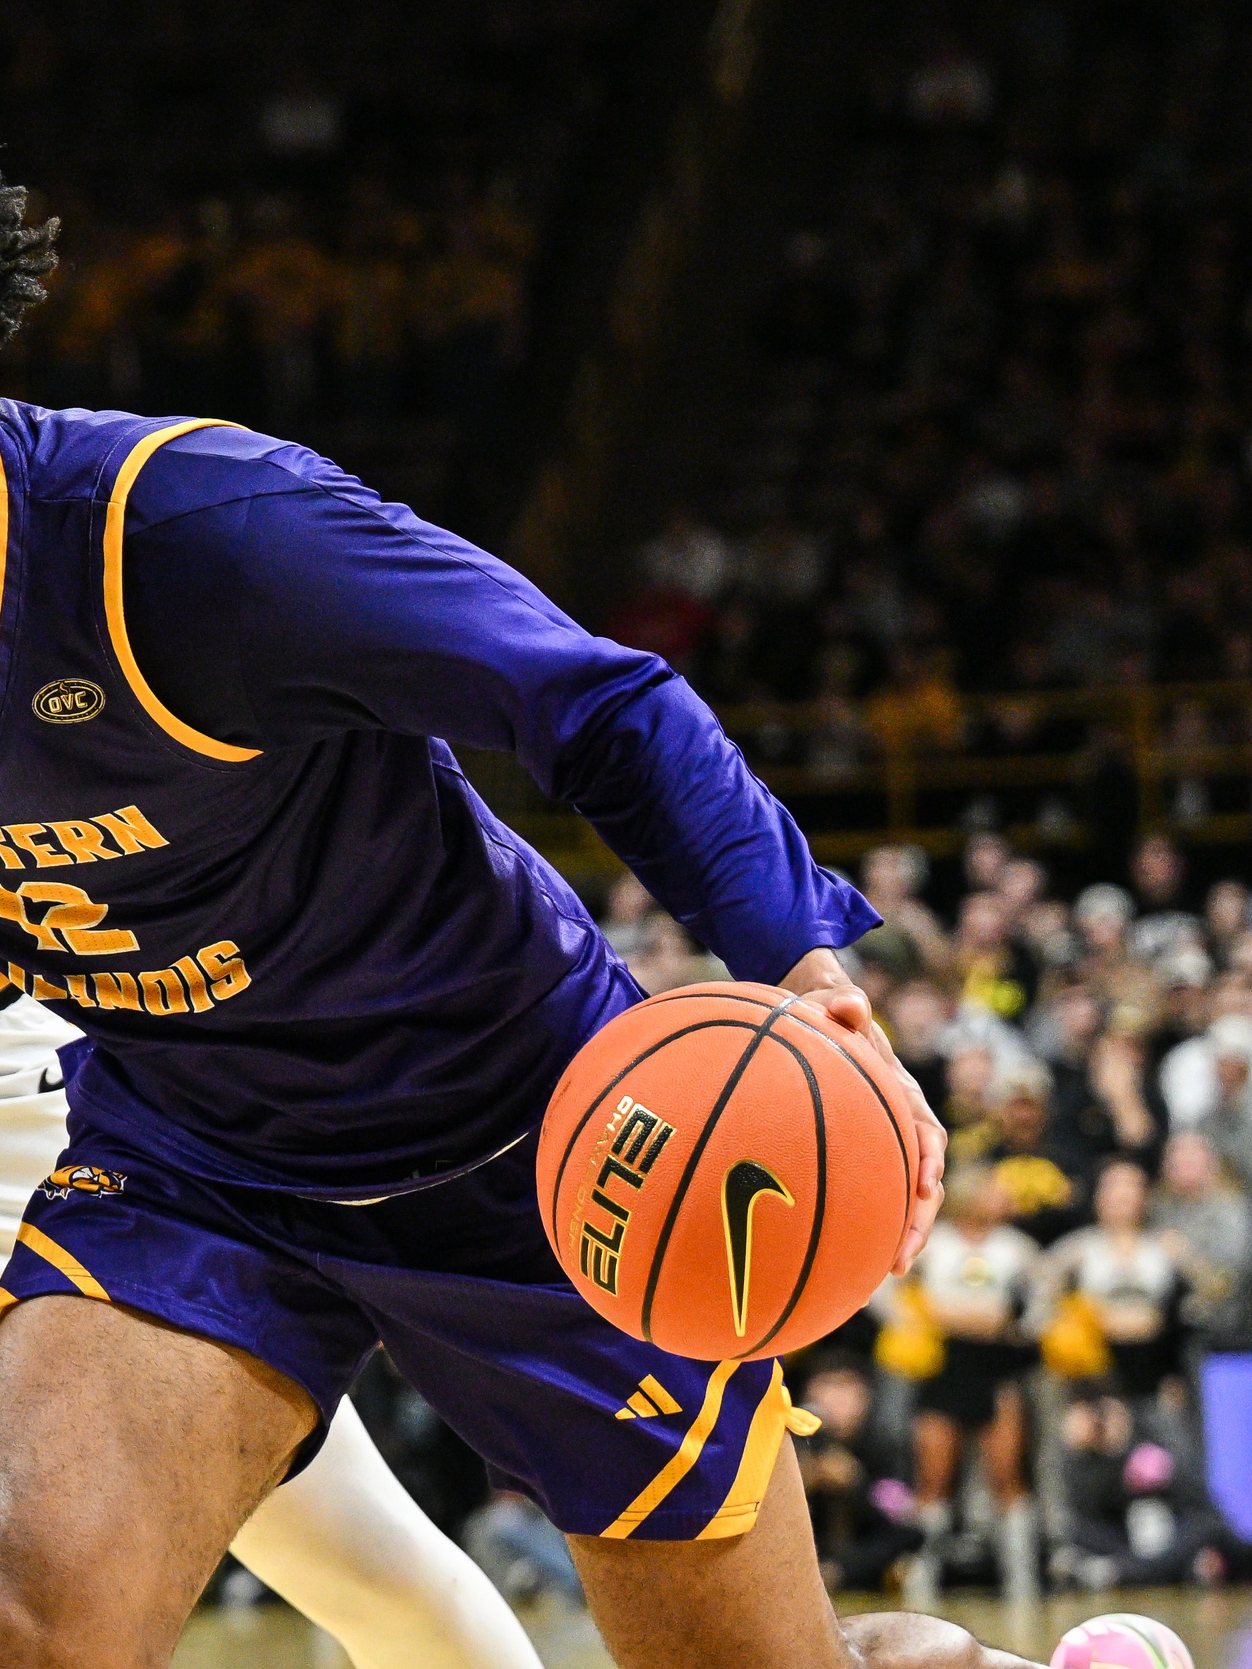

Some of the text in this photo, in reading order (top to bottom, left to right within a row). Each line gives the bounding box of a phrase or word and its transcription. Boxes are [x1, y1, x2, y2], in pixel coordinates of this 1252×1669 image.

[48, 690, 88, 714] OVC
[7, 939, 252, 1015] ILINOIS
[568, 1095, 634, 1268] CHAMPIONSH
[578, 1102, 677, 1297] ELITE
